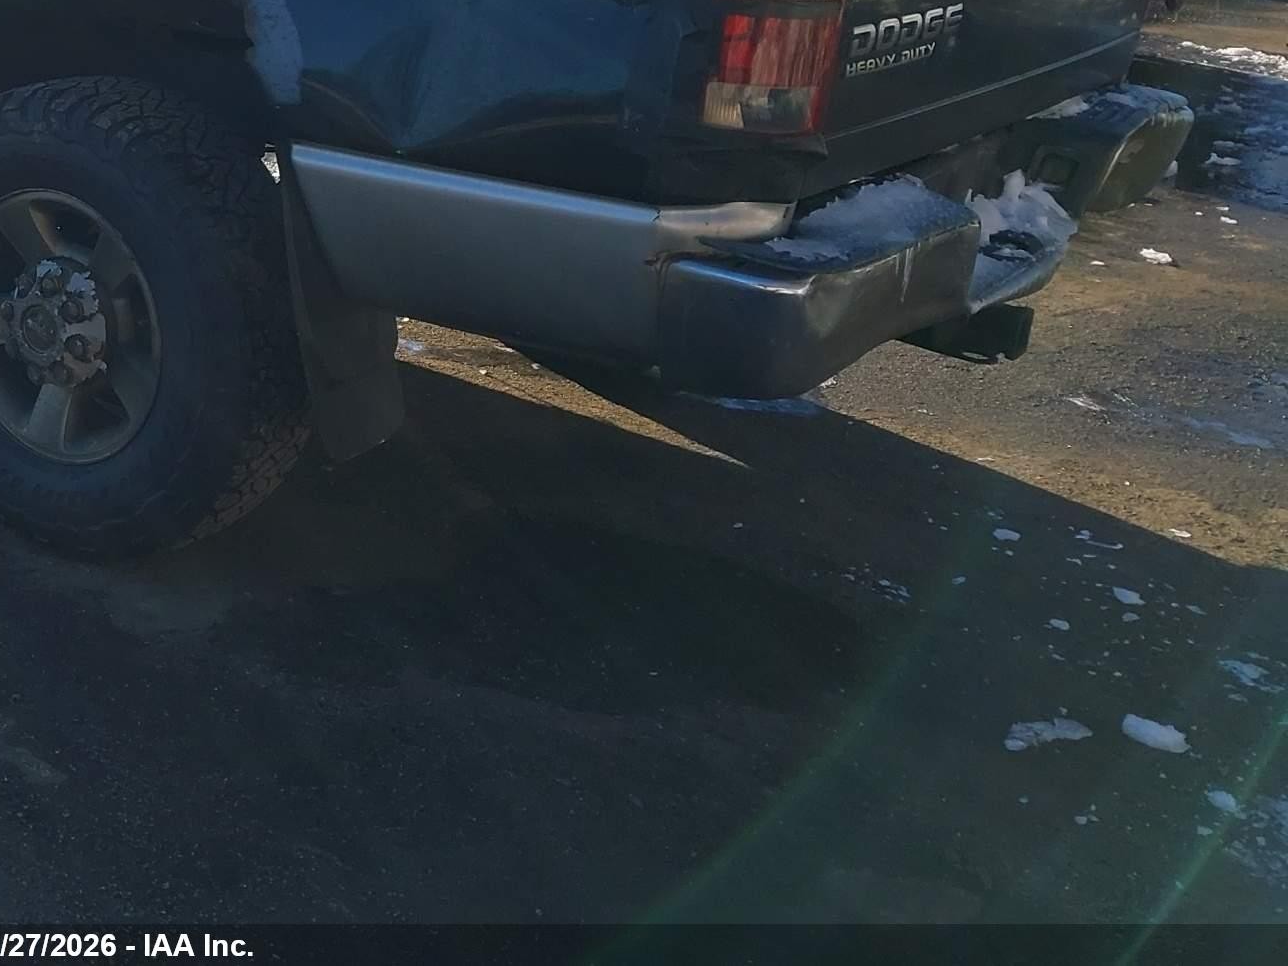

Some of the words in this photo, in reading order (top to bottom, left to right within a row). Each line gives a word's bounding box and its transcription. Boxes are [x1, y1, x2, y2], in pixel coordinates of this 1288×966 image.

[851, 2, 964, 55] DODGE
[846, 53, 896, 77] HEAVY
[901, 41, 936, 63] DUTY
